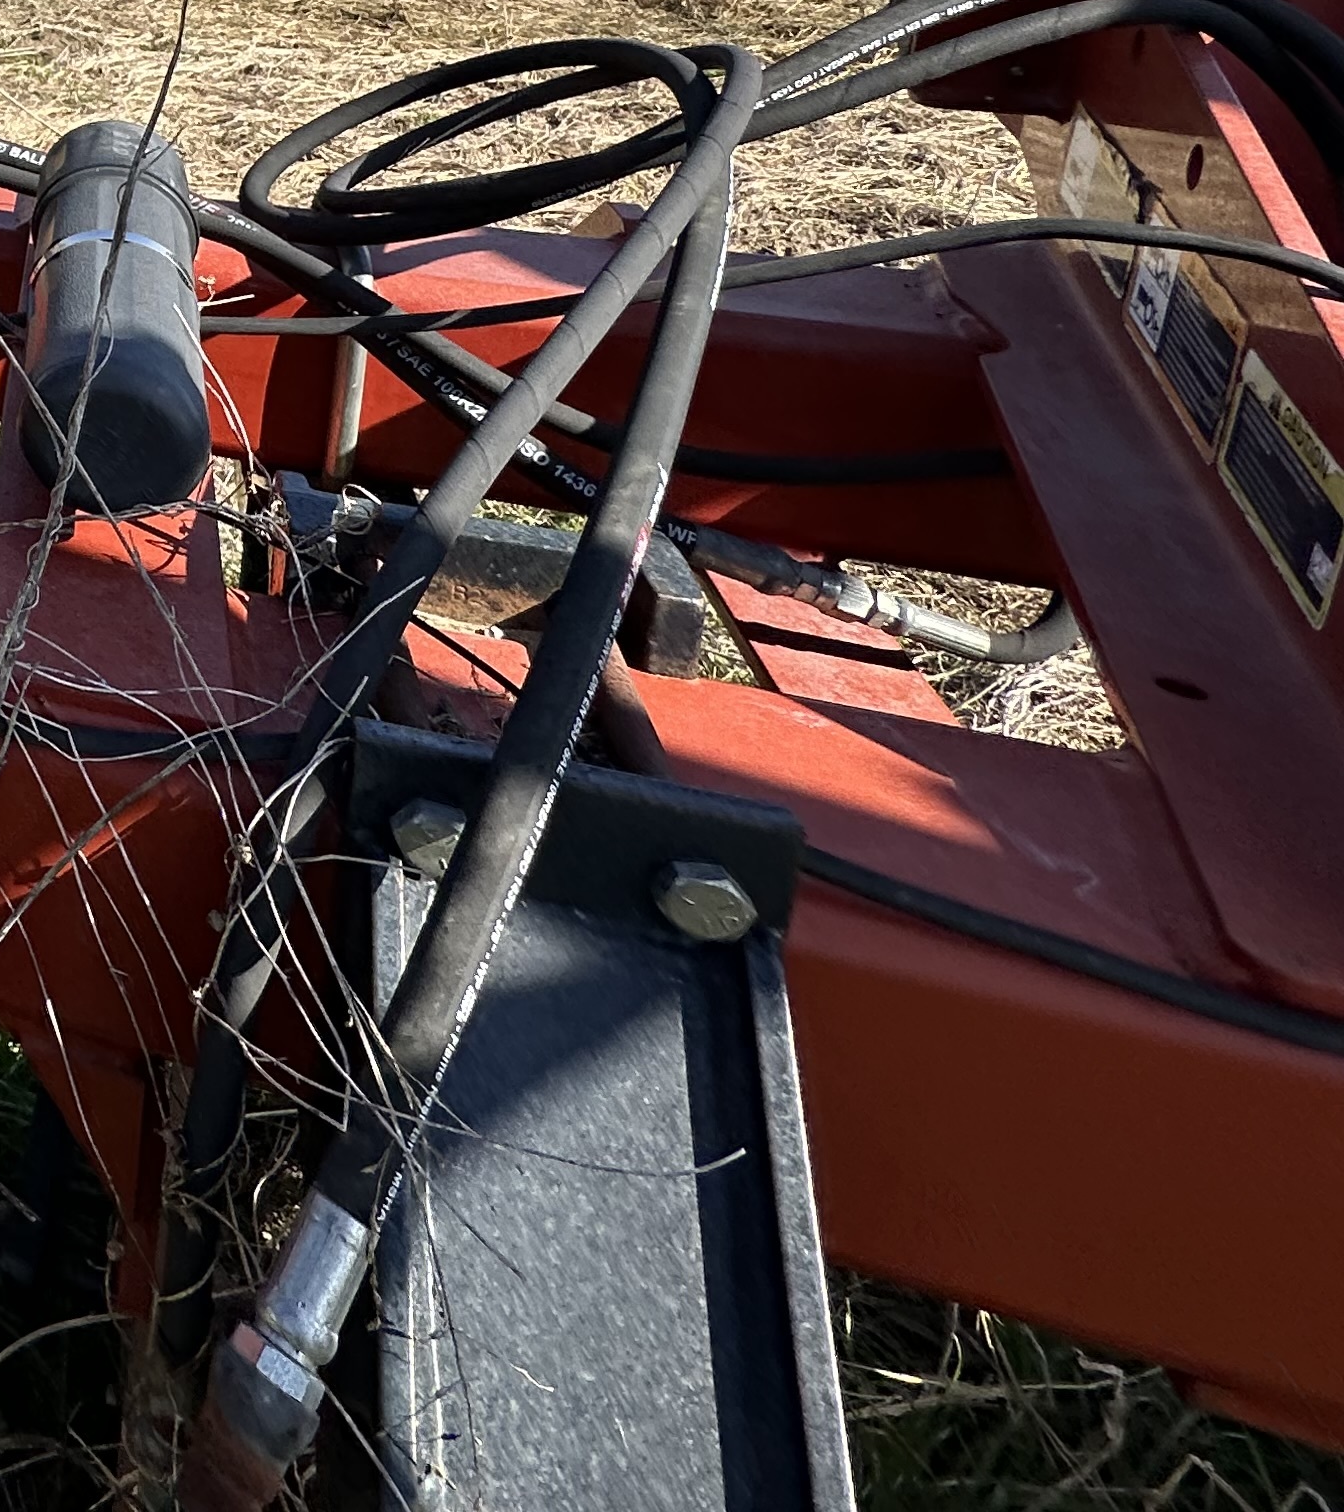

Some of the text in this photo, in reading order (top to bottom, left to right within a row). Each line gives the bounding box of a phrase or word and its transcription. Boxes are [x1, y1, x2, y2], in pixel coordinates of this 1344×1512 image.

[860, 39, 882, 55] SAE
[794, 74, 814, 89] ISO
[770, 85, 795, 101] 1436
[397, 345, 432, 377] SAE
[433, 373, 488, 421] 100R2
[553, 464, 599, 497] 1436
